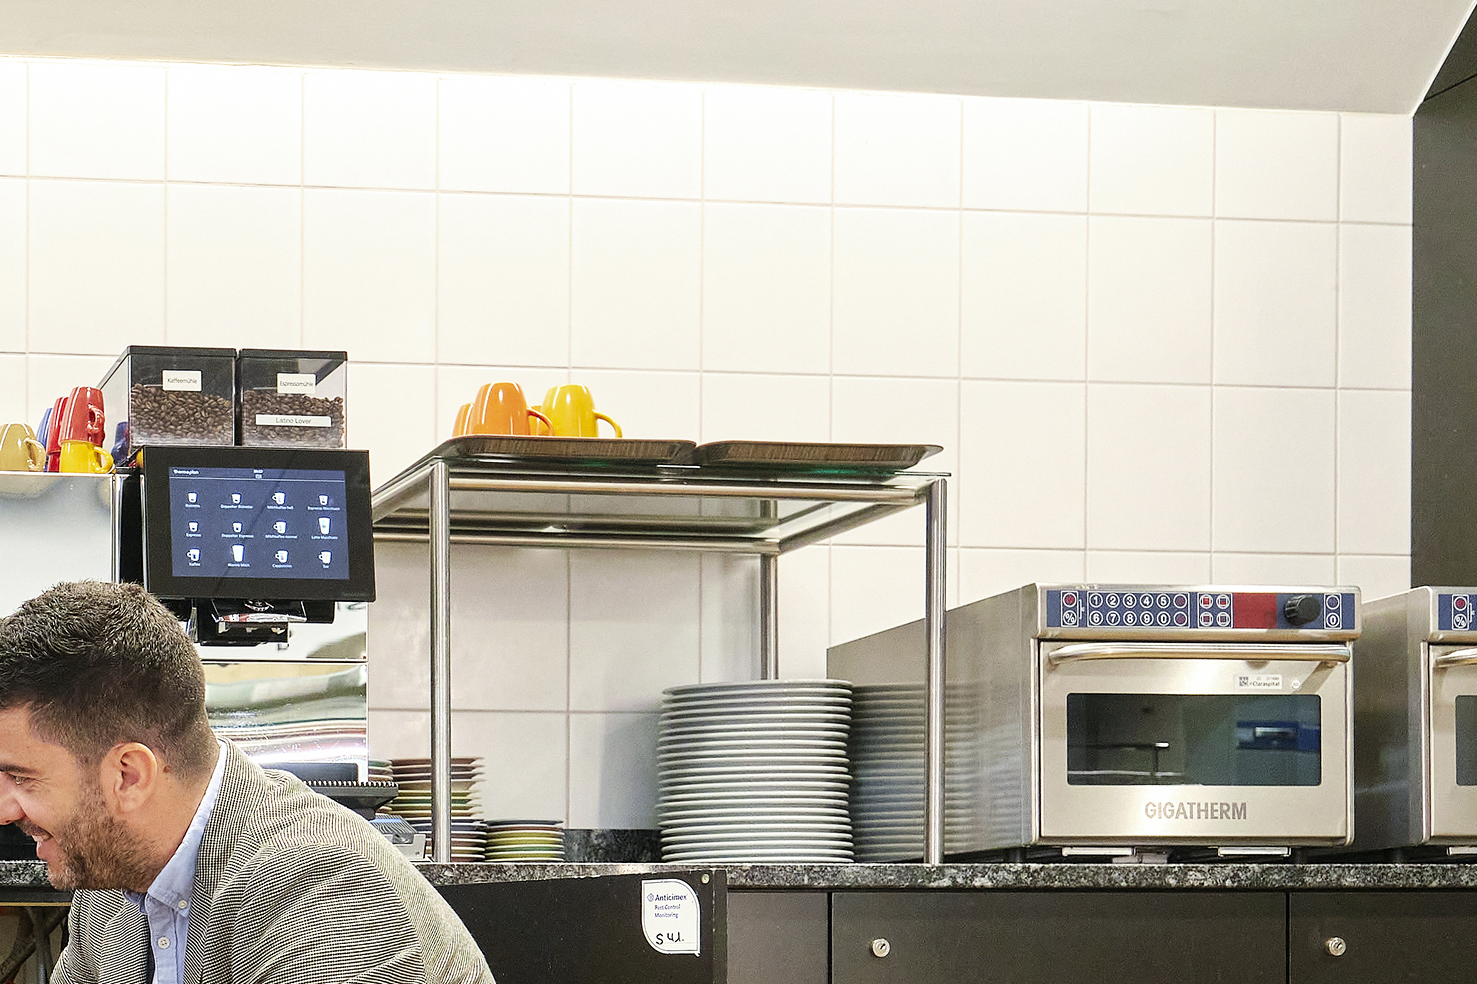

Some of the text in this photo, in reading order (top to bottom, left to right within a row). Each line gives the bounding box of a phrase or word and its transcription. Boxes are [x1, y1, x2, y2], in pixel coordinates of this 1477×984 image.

[295, 417, 312, 425] Lover
[1144, 801, 1247, 820] GIGATHERM
[655, 893, 687, 901] Anticimex
